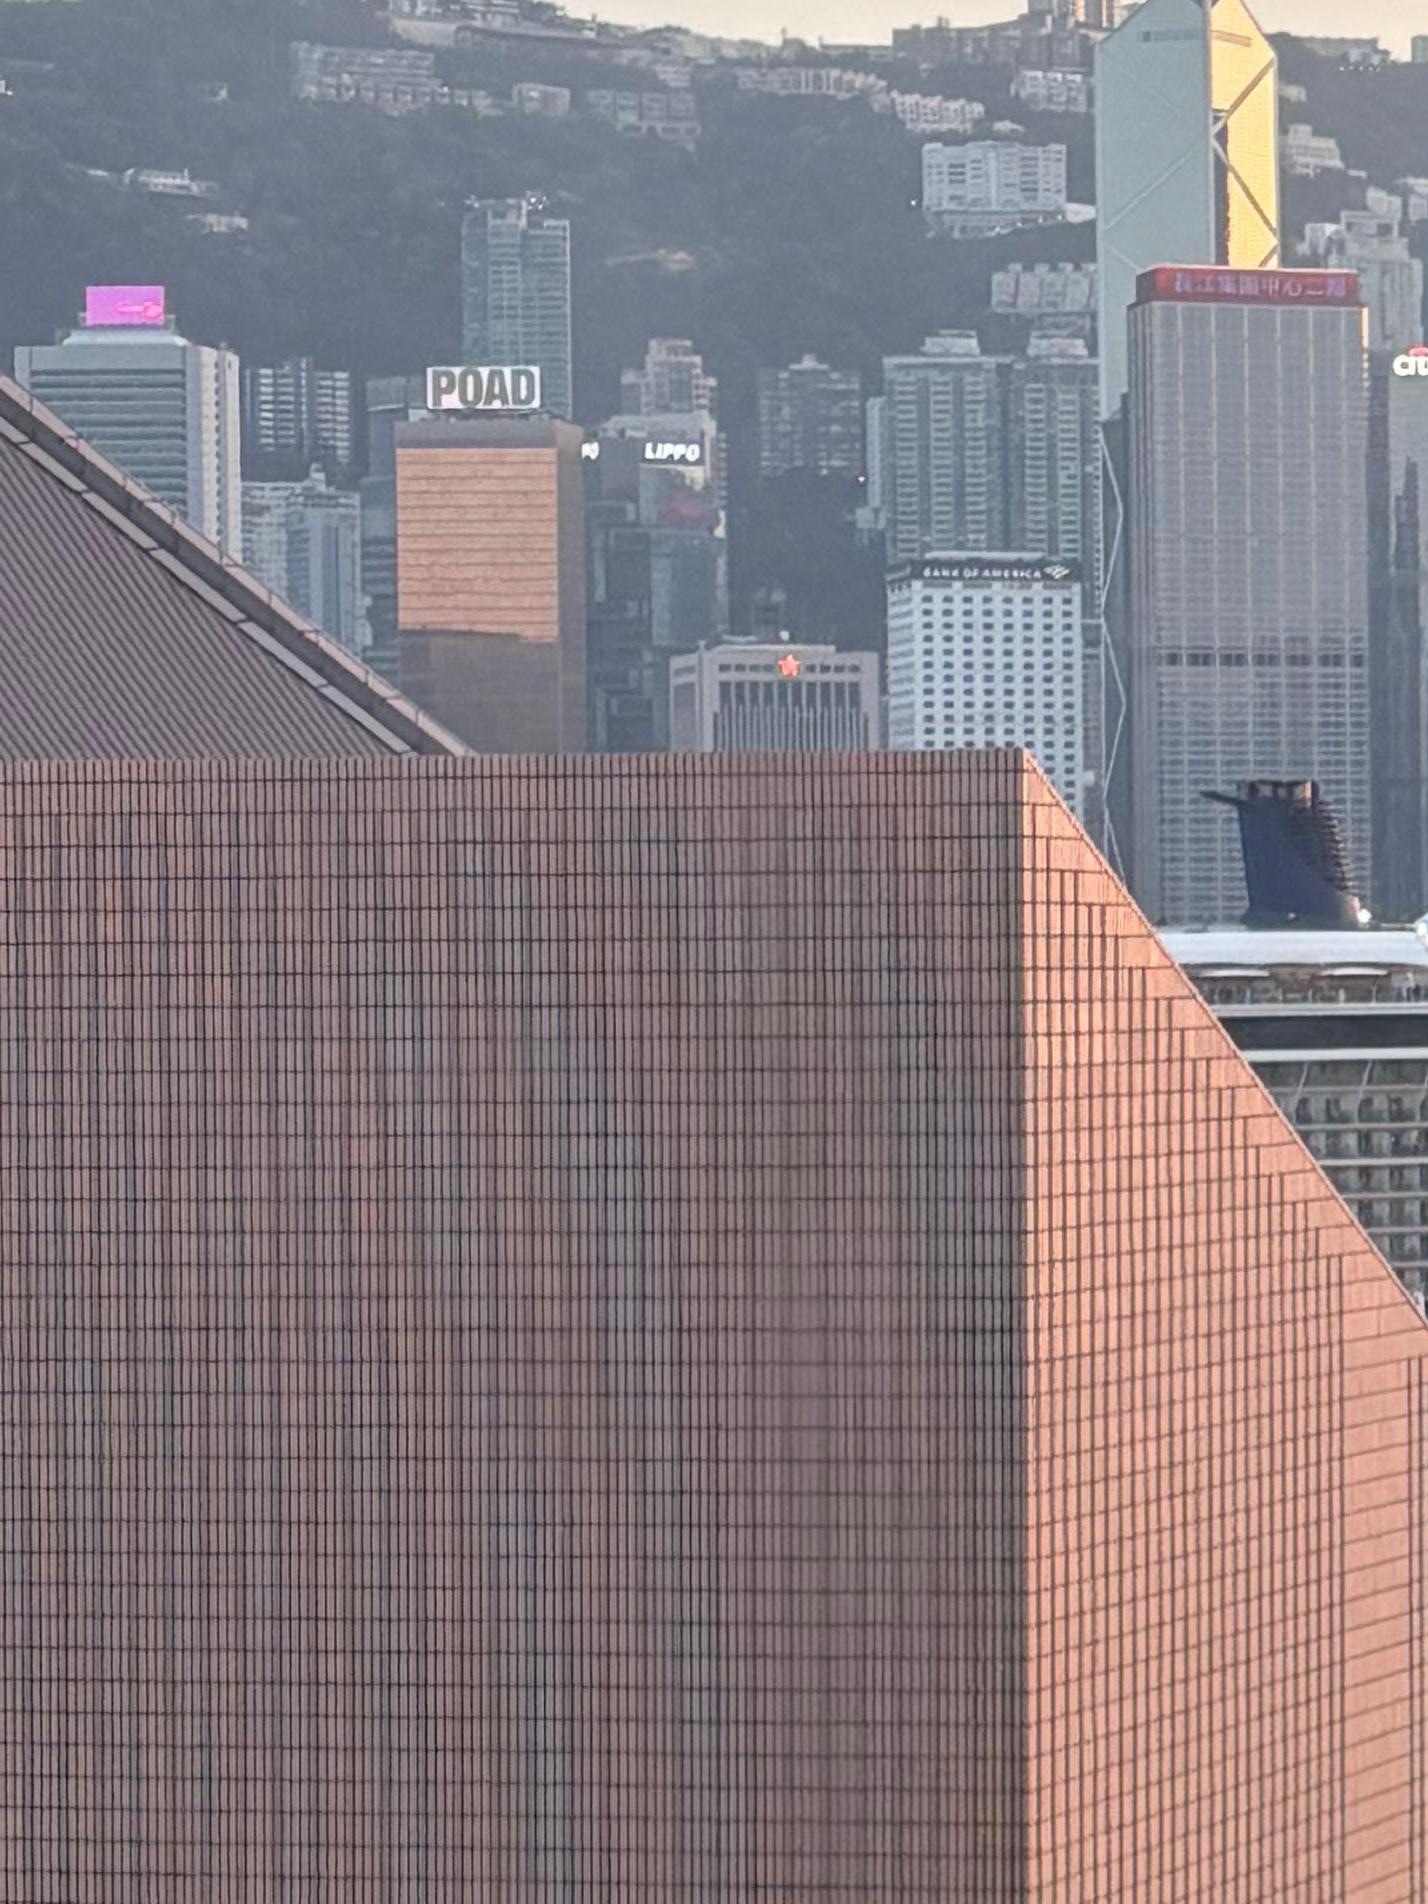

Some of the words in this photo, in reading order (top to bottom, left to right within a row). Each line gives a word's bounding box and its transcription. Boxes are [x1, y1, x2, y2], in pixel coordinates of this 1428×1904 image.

[432, 368, 535, 408] POAD
[644, 442, 700, 462] LIPPO
[923, 566, 960, 578] BANK
[963, 566, 978, 578] OF
[982, 567, 1042, 579] AMERICA
